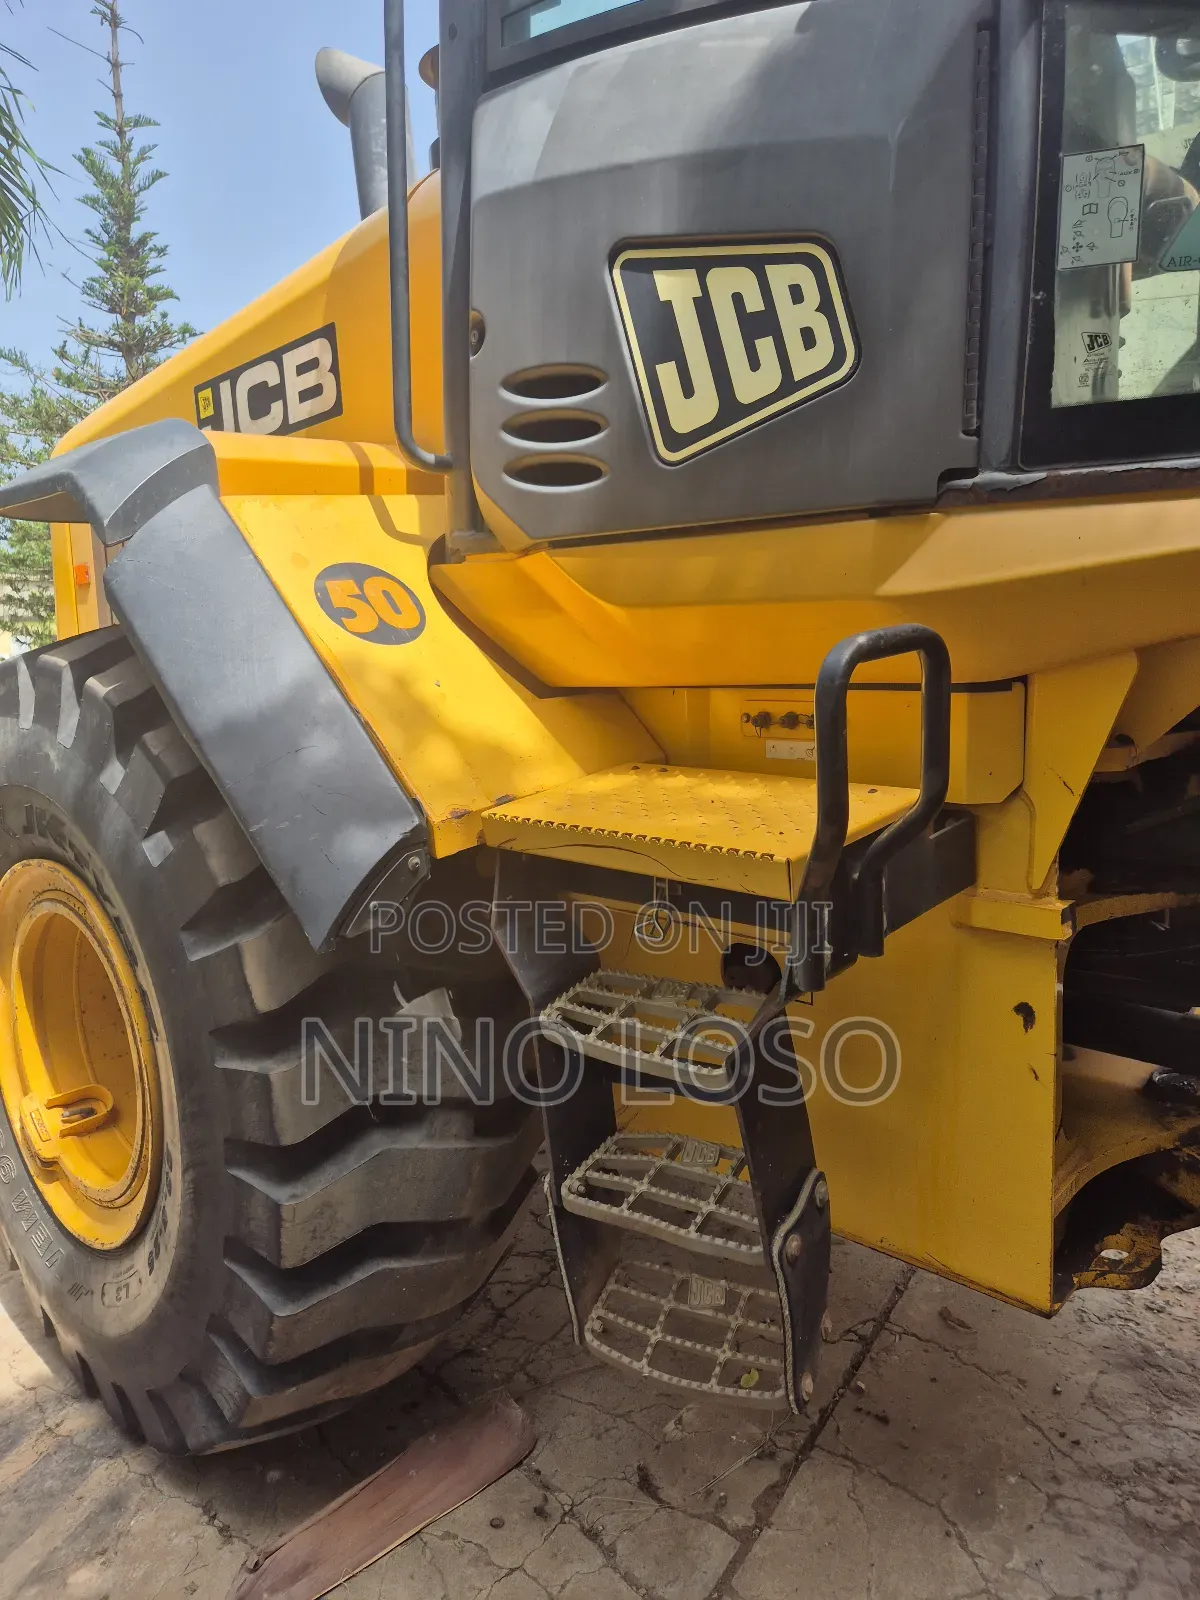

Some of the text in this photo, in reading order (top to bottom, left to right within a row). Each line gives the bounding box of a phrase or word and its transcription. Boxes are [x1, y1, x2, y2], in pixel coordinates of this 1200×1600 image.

[653, 263, 835, 434] JCB
[1087, 334, 1110, 351] JCB
[202, 337, 338, 435] JCB
[325, 576, 420, 634] 50
[682, 1141, 717, 1164] JCB
[115, 1279, 131, 1303] L3
[690, 1276, 725, 1306] JCB
